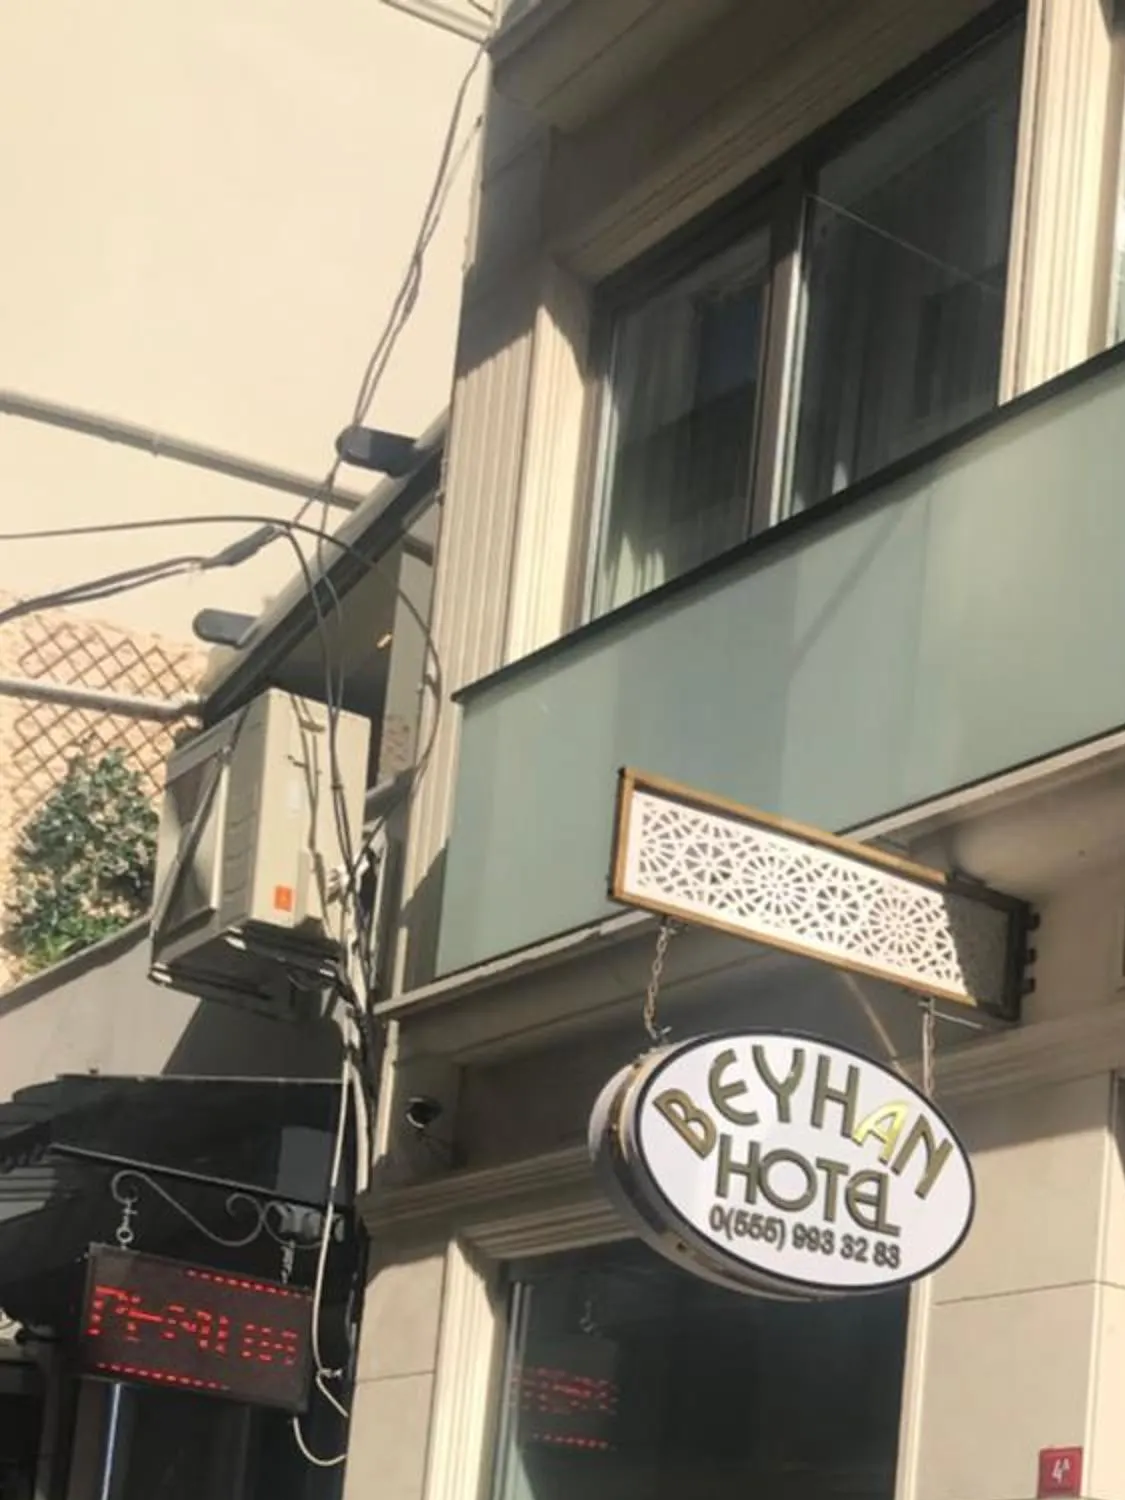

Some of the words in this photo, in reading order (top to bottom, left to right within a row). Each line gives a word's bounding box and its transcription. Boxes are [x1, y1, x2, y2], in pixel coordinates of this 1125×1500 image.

[653, 1044, 953, 1200] BEYHAN
[709, 1205, 787, 1252] 0(555)
[715, 1134, 901, 1238] HOTEL
